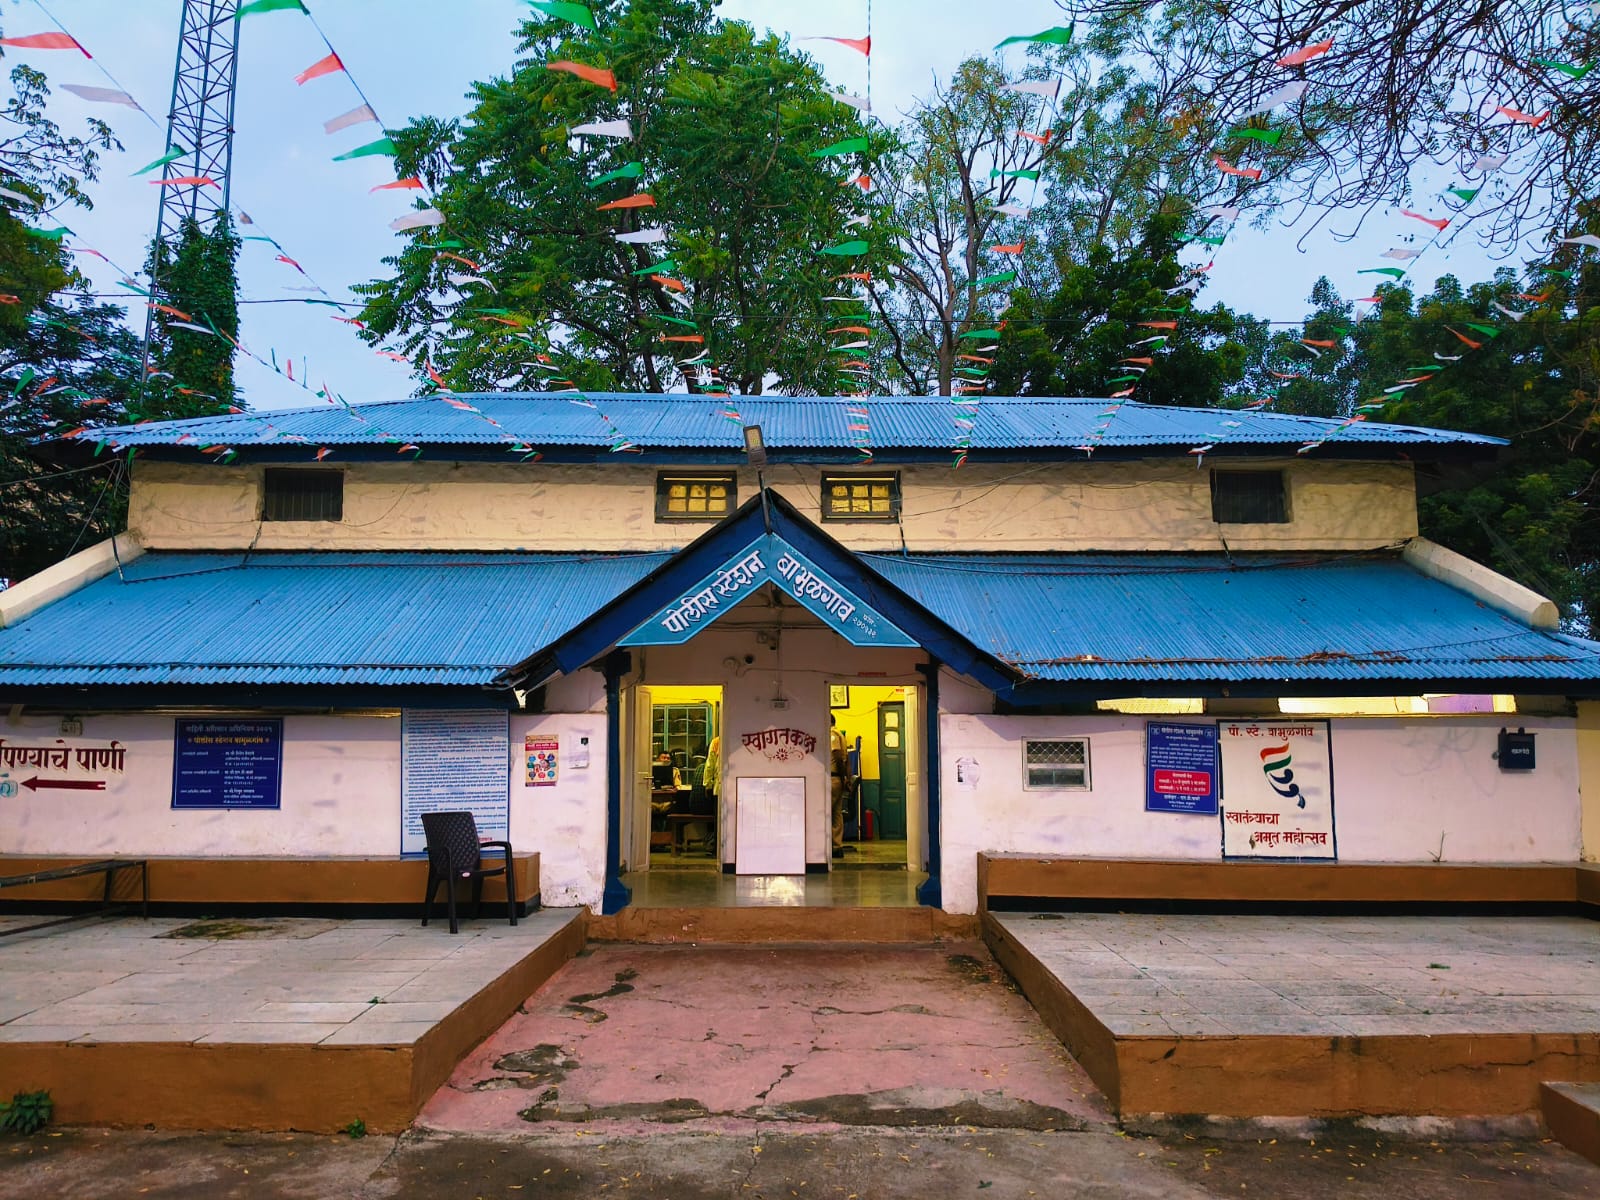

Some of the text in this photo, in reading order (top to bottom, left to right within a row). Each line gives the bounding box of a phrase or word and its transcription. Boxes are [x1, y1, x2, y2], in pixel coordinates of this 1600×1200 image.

[661, 550, 767, 633] पोलीस स्टेशन
[776, 552, 856, 624] बाभुळगाव
[0, 739, 127, 771] पिण्याचे पाणी
[1254, 827, 1328, 848] अमृत महोत्सव
